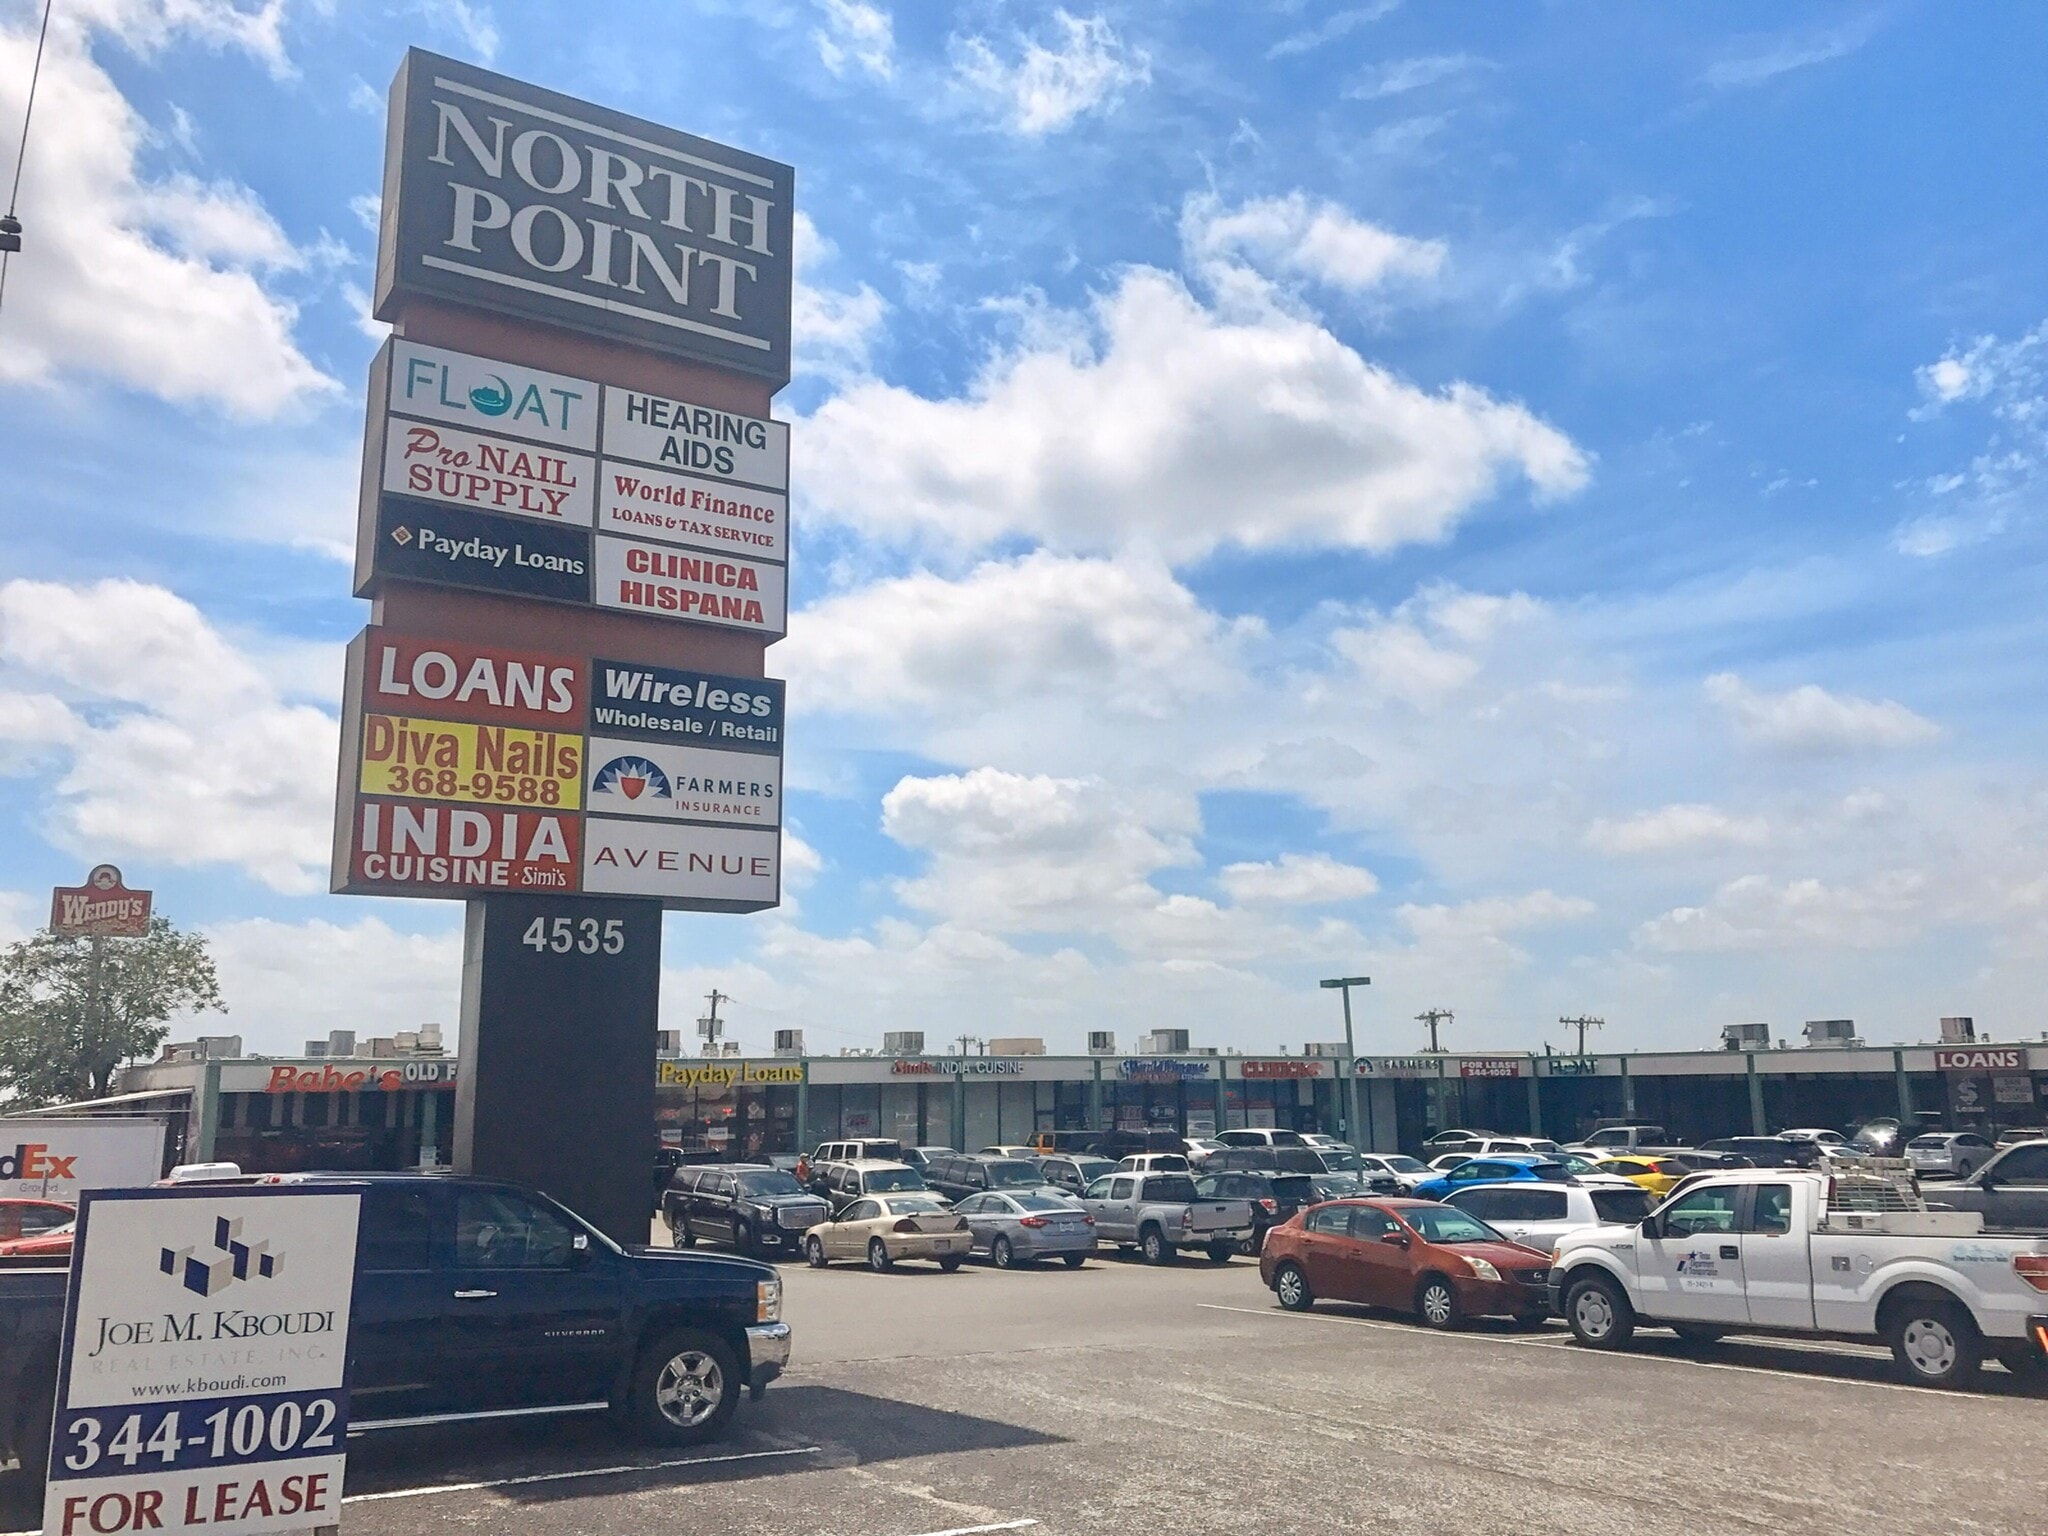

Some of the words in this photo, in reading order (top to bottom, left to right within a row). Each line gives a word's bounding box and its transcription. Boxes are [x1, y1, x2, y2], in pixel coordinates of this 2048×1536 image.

[428, 99, 775, 257] NORTH
[443, 181, 757, 320] POINT
[405, 357, 583, 431] FLOAT
[626, 394, 767, 450] HEARING
[404, 427, 473, 468] Pro
[476, 443, 577, 488] NAIL
[659, 435, 735, 475] AIDS
[408, 463, 570, 516] SUPPLY
[614, 475, 687, 508] World
[689, 490, 775, 524] Finance
[611, 507, 664, 528] LOANS
[664, 515, 677, 529] &
[678, 518, 712, 536] TAX
[713, 525, 775, 548] SERVICE
[418, 528, 509, 569] Payday
[514, 543, 585, 577] Loans
[625, 548, 759, 592] CLINICA
[620, 580, 764, 624] HISPANA
[378, 646, 575, 714] LOANS
[605, 668, 772, 718] Wireless
[595, 706, 703, 735] Wholesale
[721, 721, 778, 743] Retail
[365, 715, 460, 769] Diva
[475, 725, 579, 781] Nails
[386, 764, 561, 806] 368-9588
[675, 775, 775, 799] FARMERS
[675, 800, 762, 816] INSURANCE
[361, 803, 571, 865] INDIA
[363, 853, 509, 887] CUISINE
[520, 866, 567, 888] Simi's
[593, 846, 772, 877] AVENUE
[522, 916, 625, 956] 4535
[264, 1063, 402, 1093] Babe's
[405, 1062, 438, 1081] OLD
[660, 1061, 738, 1088] Payday
[743, 1062, 804, 1083] Loans
[976, 1060, 1025, 1074] CUISINE
[1461, 1061, 1484, 1069] FOR
[1485, 1061, 1519, 1069] LEASE
[1467, 1068, 1513, 1077] 344-1002
[1939, 1051, 2019, 1068] LOANS
[88, 1316, 154, 1358] JOE
[159, 1312, 203, 1343] M.
[210, 1309, 335, 1341] KBOUDI
[92, 1358, 155, 1375] REAL
[131, 1374, 287, 1397] www.kboudi.com
[64, 1398, 338, 1471] 344-1002
[62, 1489, 164, 1536] FOR
[184, 1473, 330, 1526] LEASE
